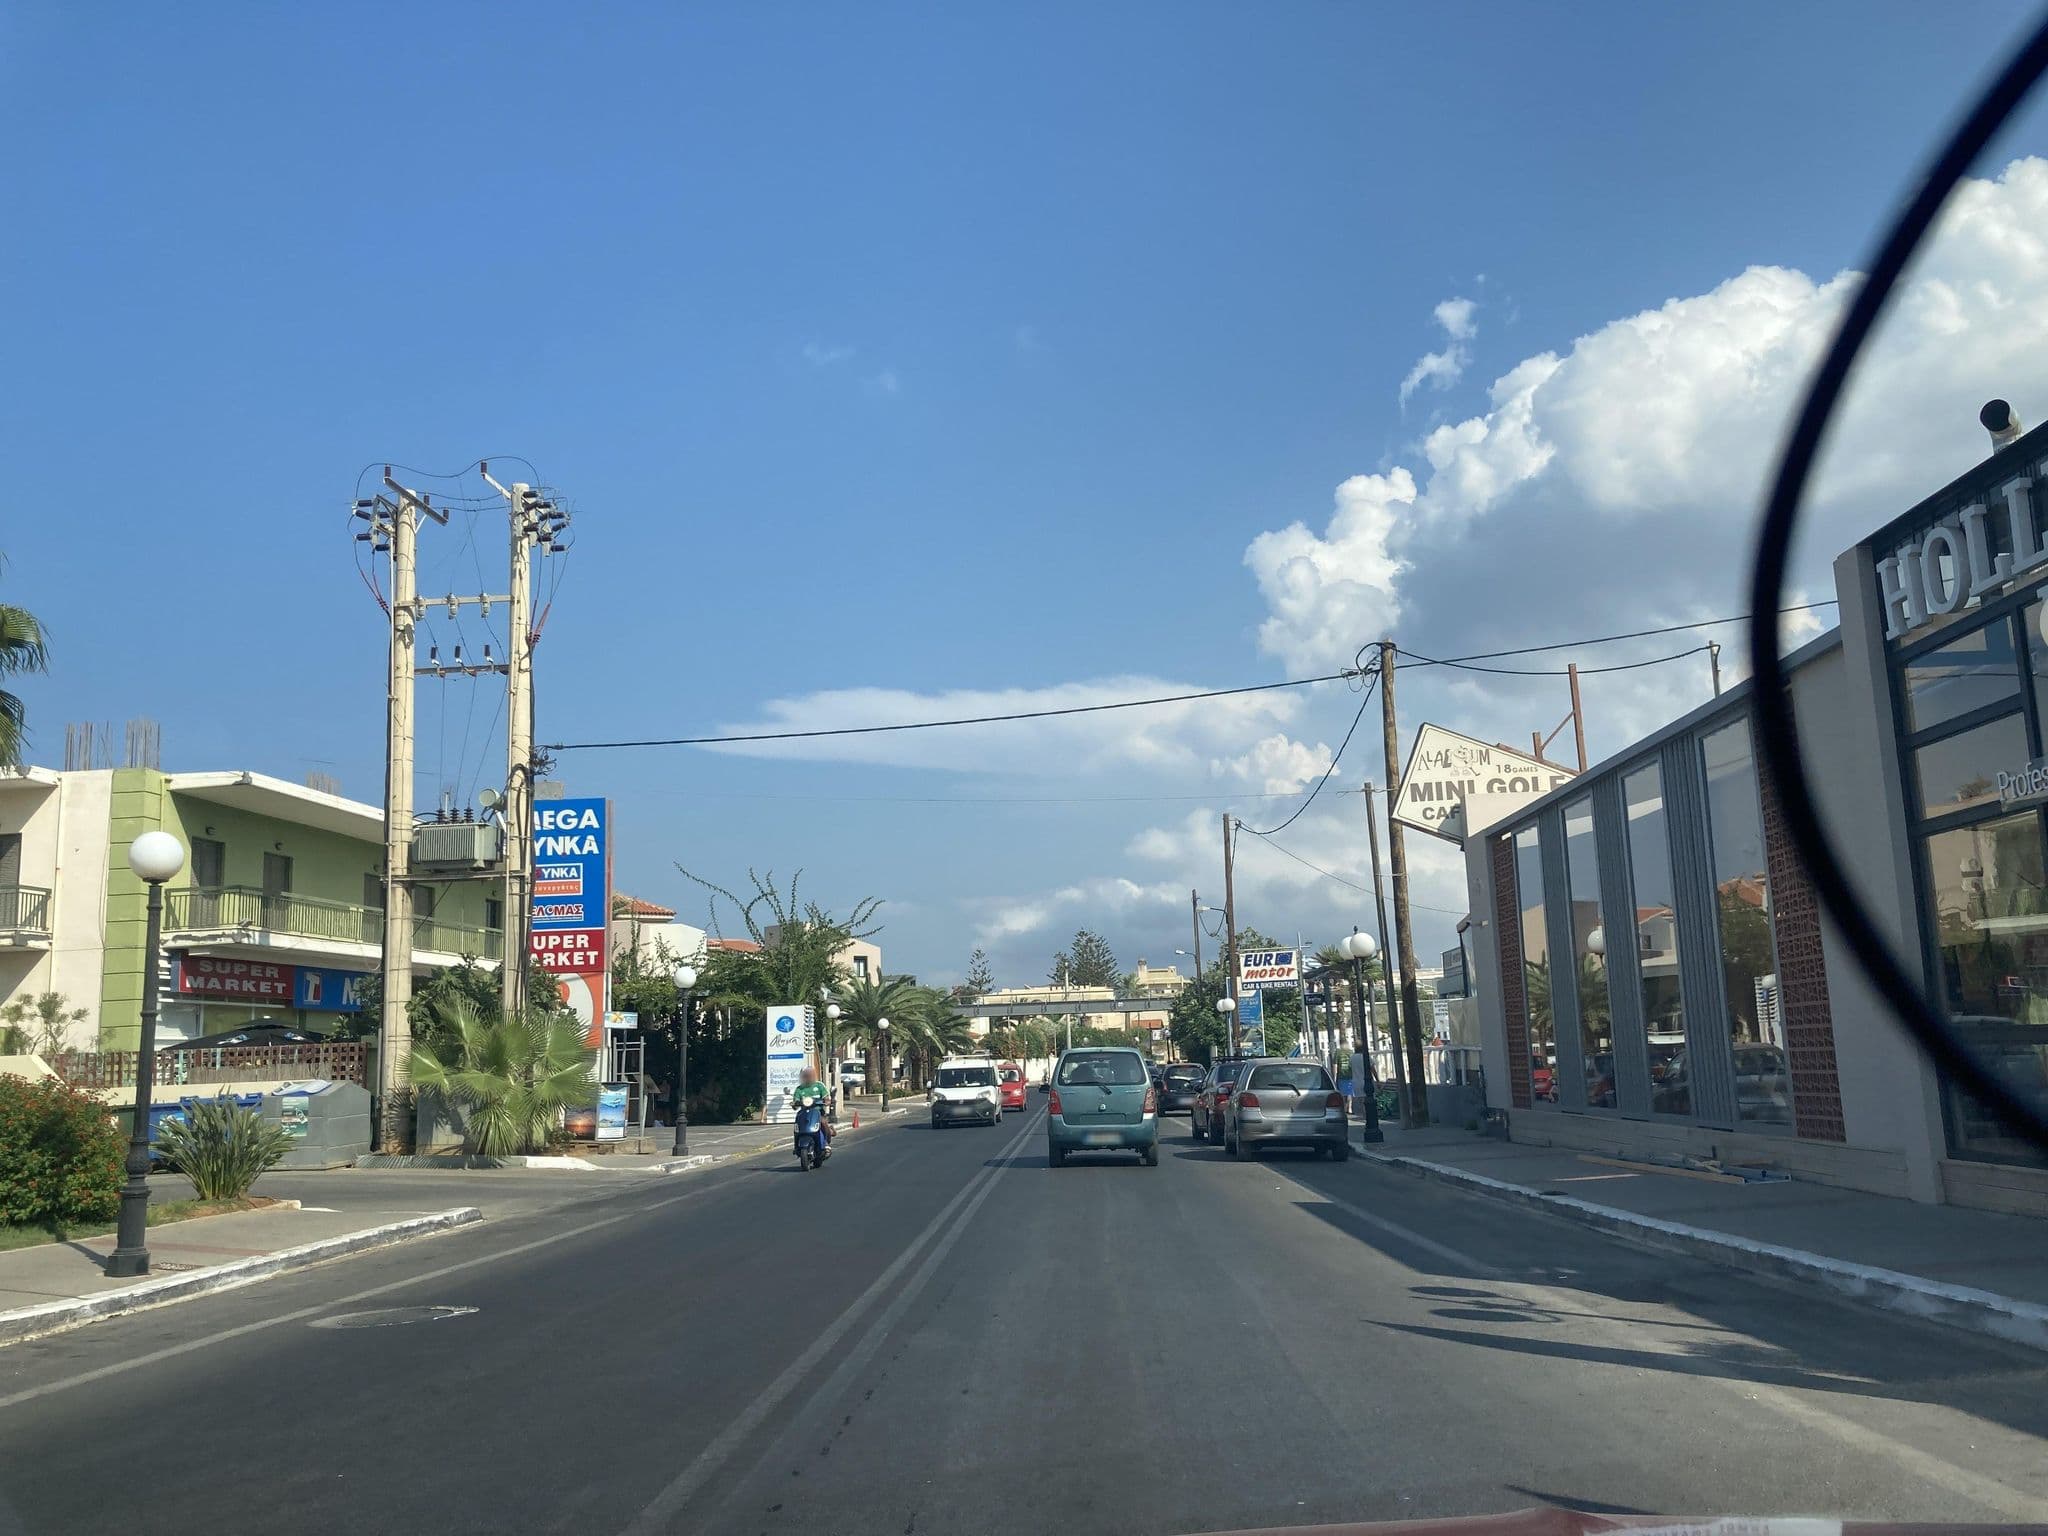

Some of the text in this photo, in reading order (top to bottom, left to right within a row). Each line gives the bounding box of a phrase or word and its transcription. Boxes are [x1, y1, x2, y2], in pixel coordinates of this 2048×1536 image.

[1876, 458, 2048, 641] HOLL
[1496, 764, 1512, 774] 18
[1410, 779, 1476, 802] MINI
[1422, 806, 1461, 821] CAF
[533, 934, 589, 950] UPER
[530, 951, 599, 967] ARKET
[199, 959, 280, 979] SUPER
[1244, 967, 1296, 980] motor
[186, 975, 287, 994] MARKET
